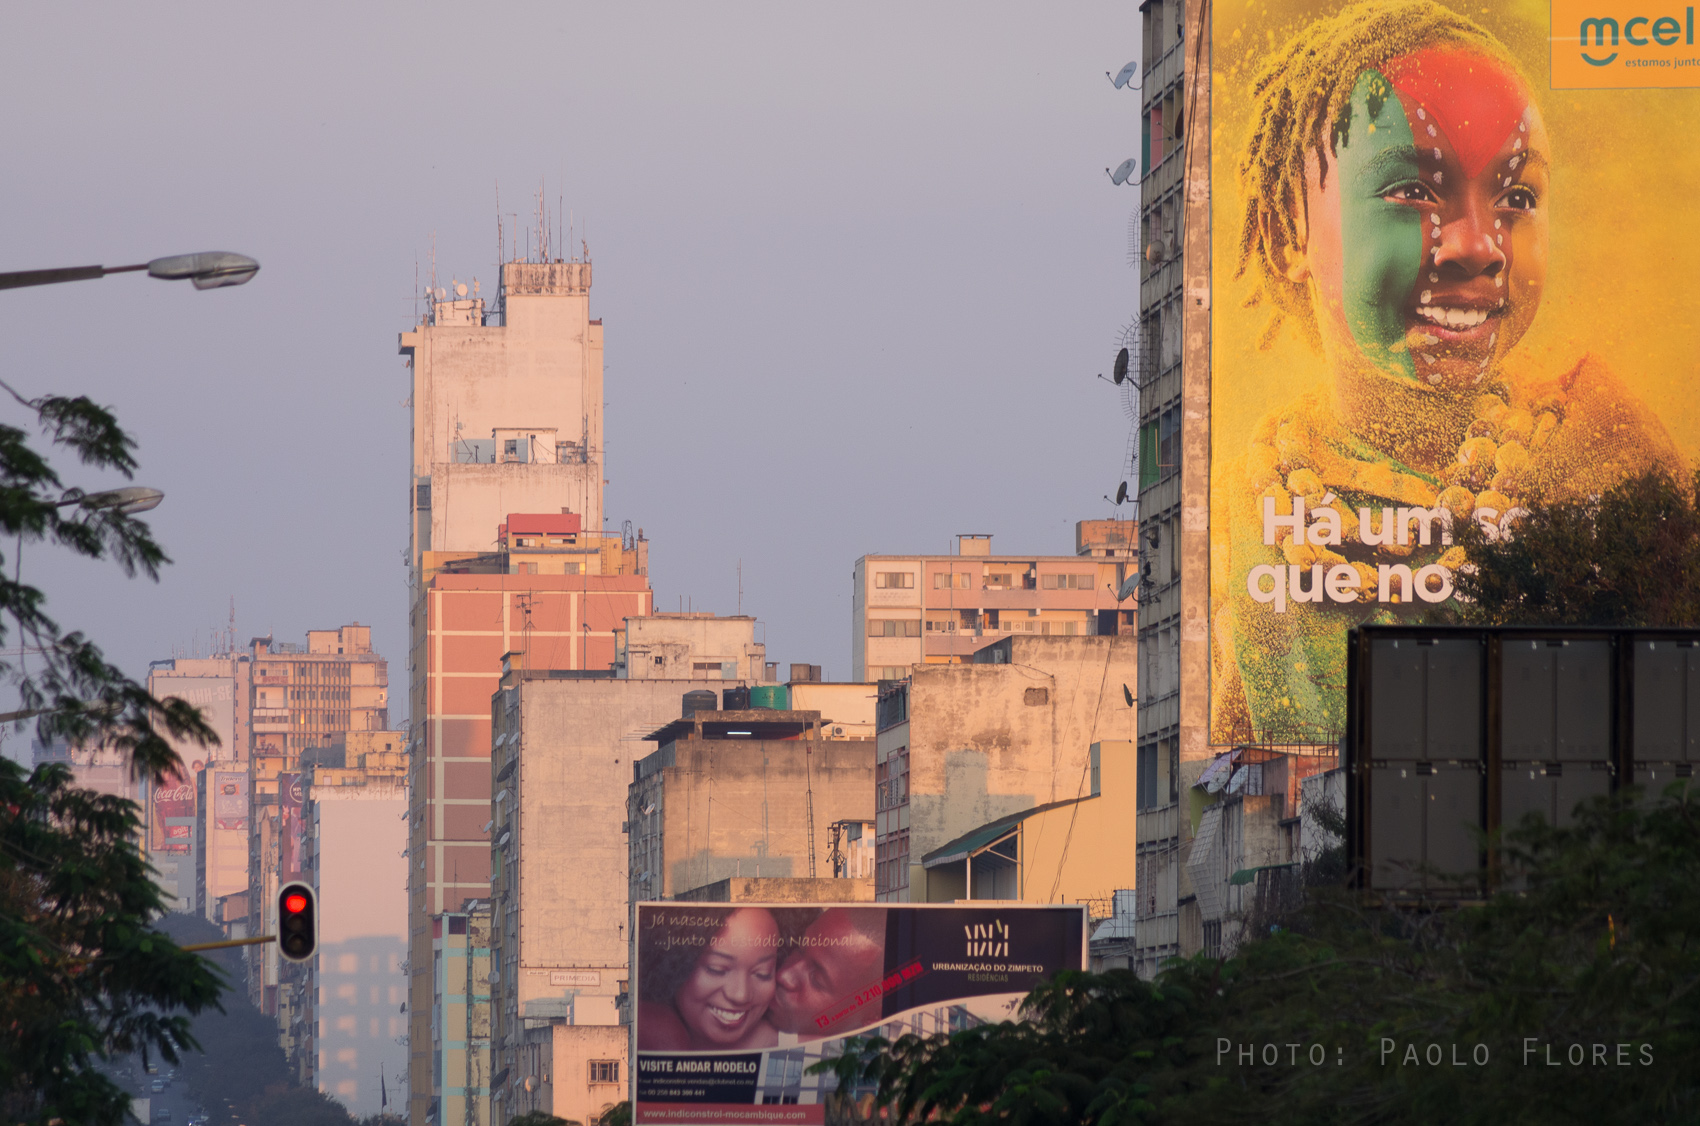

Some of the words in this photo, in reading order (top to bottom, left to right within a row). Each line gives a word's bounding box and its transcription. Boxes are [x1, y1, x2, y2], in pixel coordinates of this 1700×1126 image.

[1580, 6, 1694, 46] mcel
[1625, 58, 1671, 67] estamos
[1263, 493, 1341, 545] Há
[1359, 507, 1452, 545] um
[1247, 563, 1361, 613] que
[154, 784, 194, 803] Coca-Cola
[650, 912, 665, 928] Já
[654, 931, 706, 950] ...junto
[709, 935, 726, 947] ao
[730, 934, 785, 947] Estádio
[789, 934, 855, 947] Nacional
[932, 962, 992, 973] URBANIZAÇÃO
[993, 964, 1006, 972] DO
[1007, 964, 1044, 973] ZIMPETO
[967, 973, 1009, 982] RESIDÊNCIAS
[640, 1060, 674, 1072] VISITE
[675, 1061, 711, 1073] ANDAR
[714, 1061, 757, 1073] MODELO
